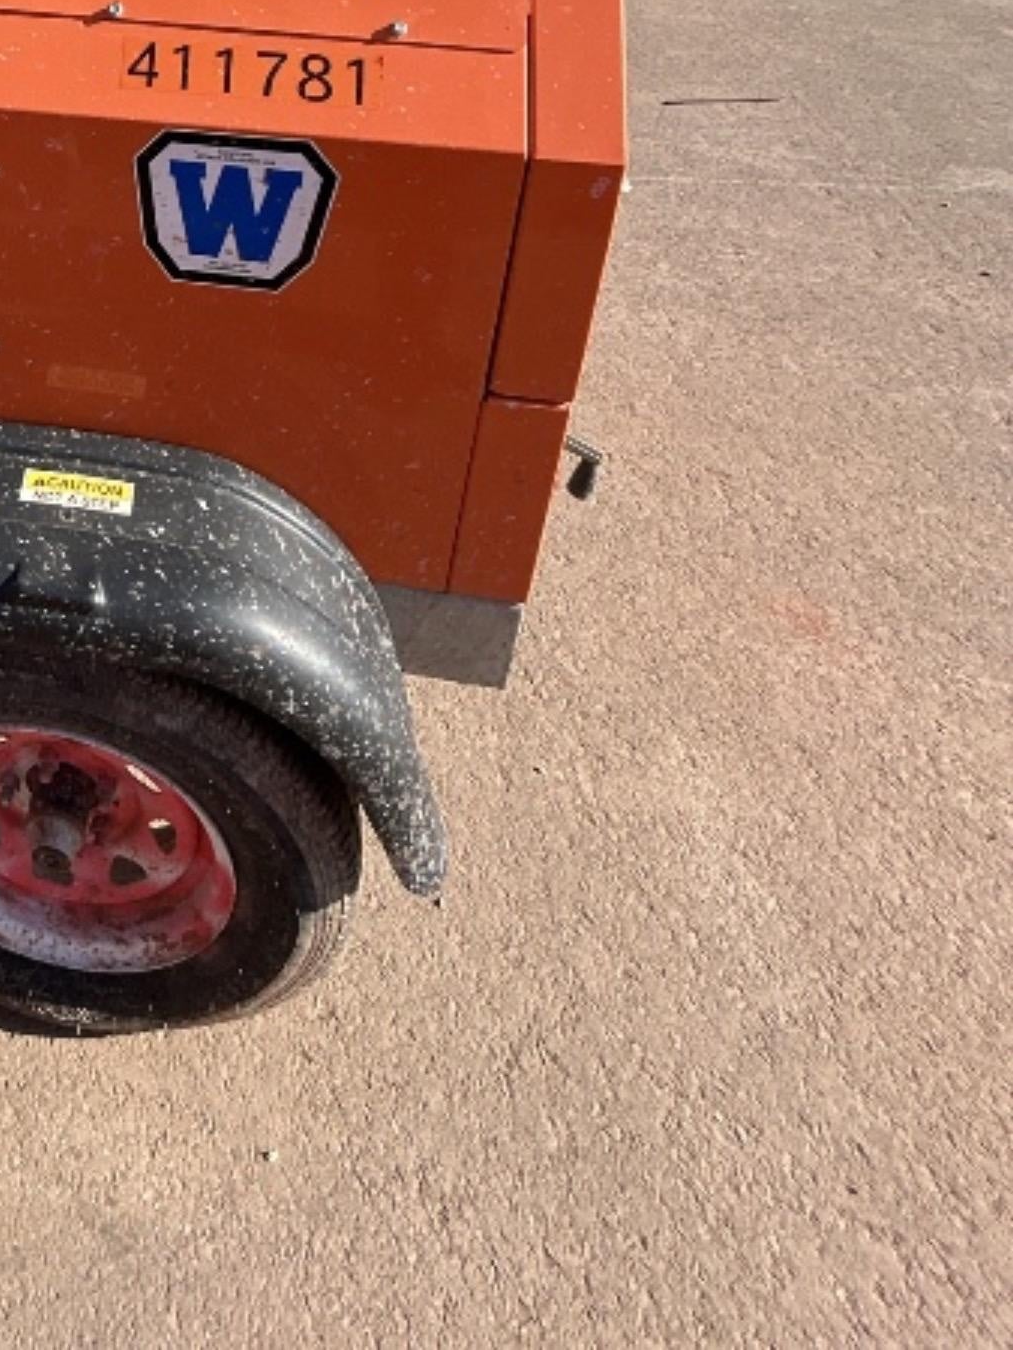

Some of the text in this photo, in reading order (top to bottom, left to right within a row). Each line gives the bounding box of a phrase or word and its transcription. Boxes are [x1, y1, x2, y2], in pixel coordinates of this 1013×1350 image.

[127, 41, 364, 106] 411781
[168, 158, 305, 263] W
[46, 476, 123, 498] CAUTION
